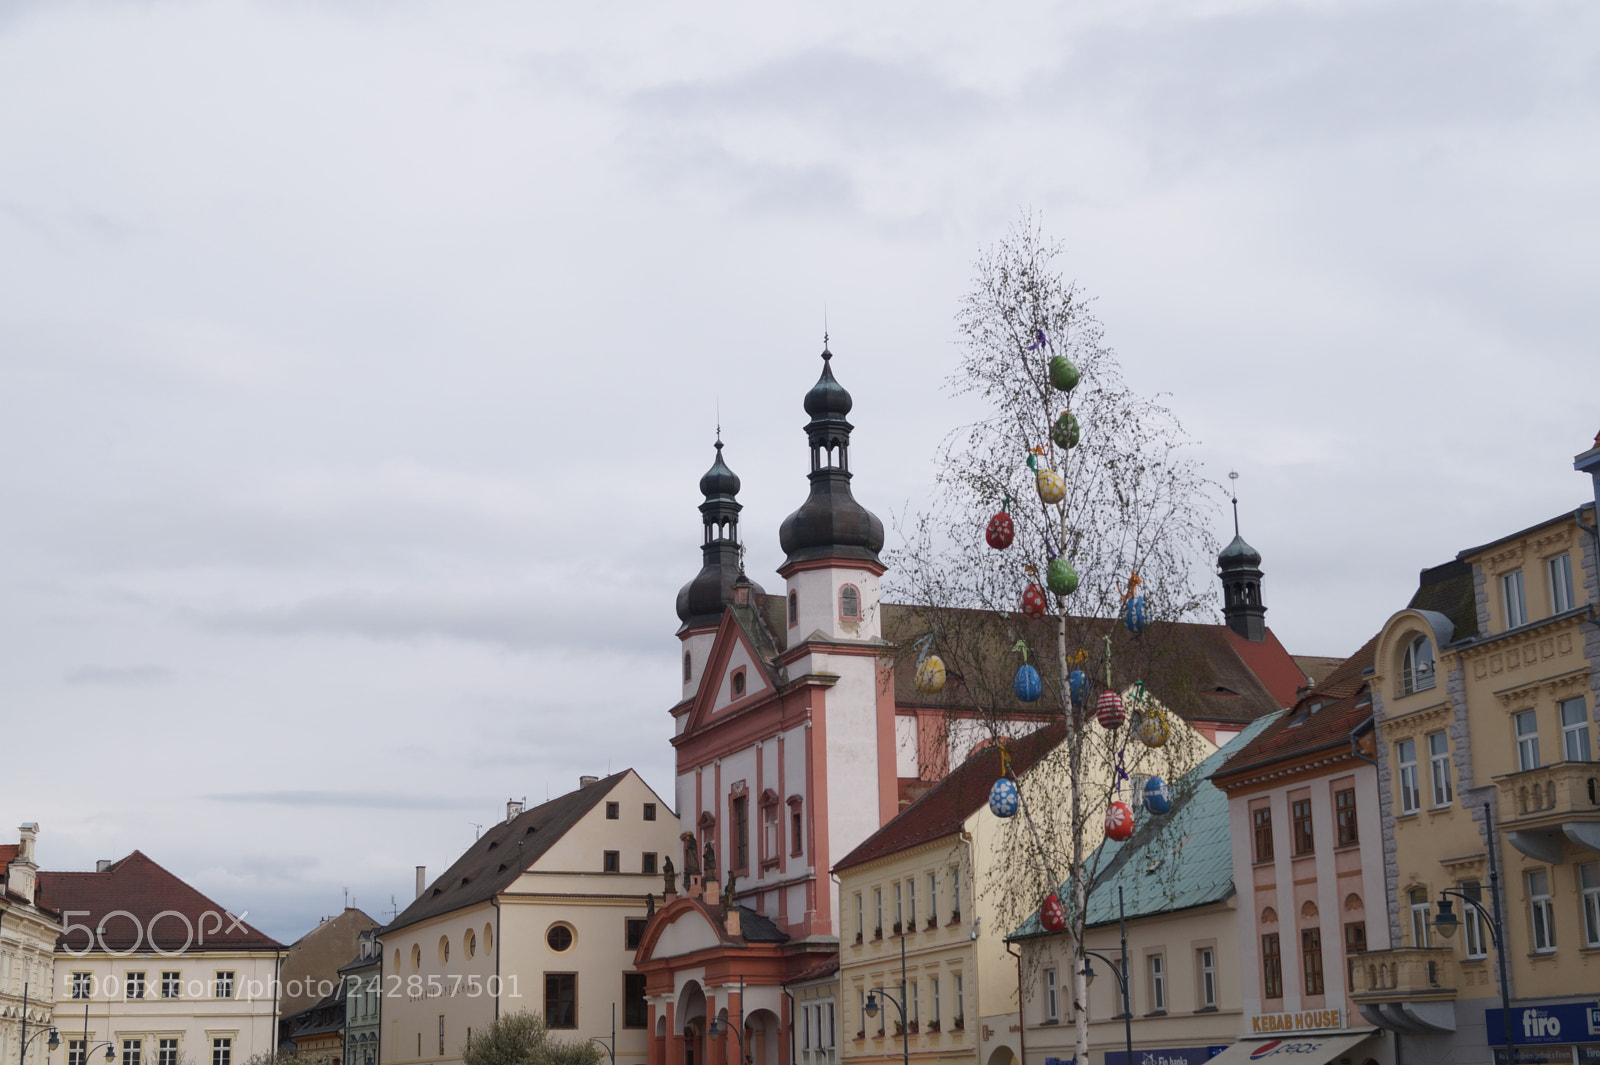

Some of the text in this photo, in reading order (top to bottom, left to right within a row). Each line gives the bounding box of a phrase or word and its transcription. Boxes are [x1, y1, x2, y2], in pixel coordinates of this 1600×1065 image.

[1252, 1010, 1339, 1032] KEBAB HOUSE
[1522, 1008, 1561, 1037] firo
